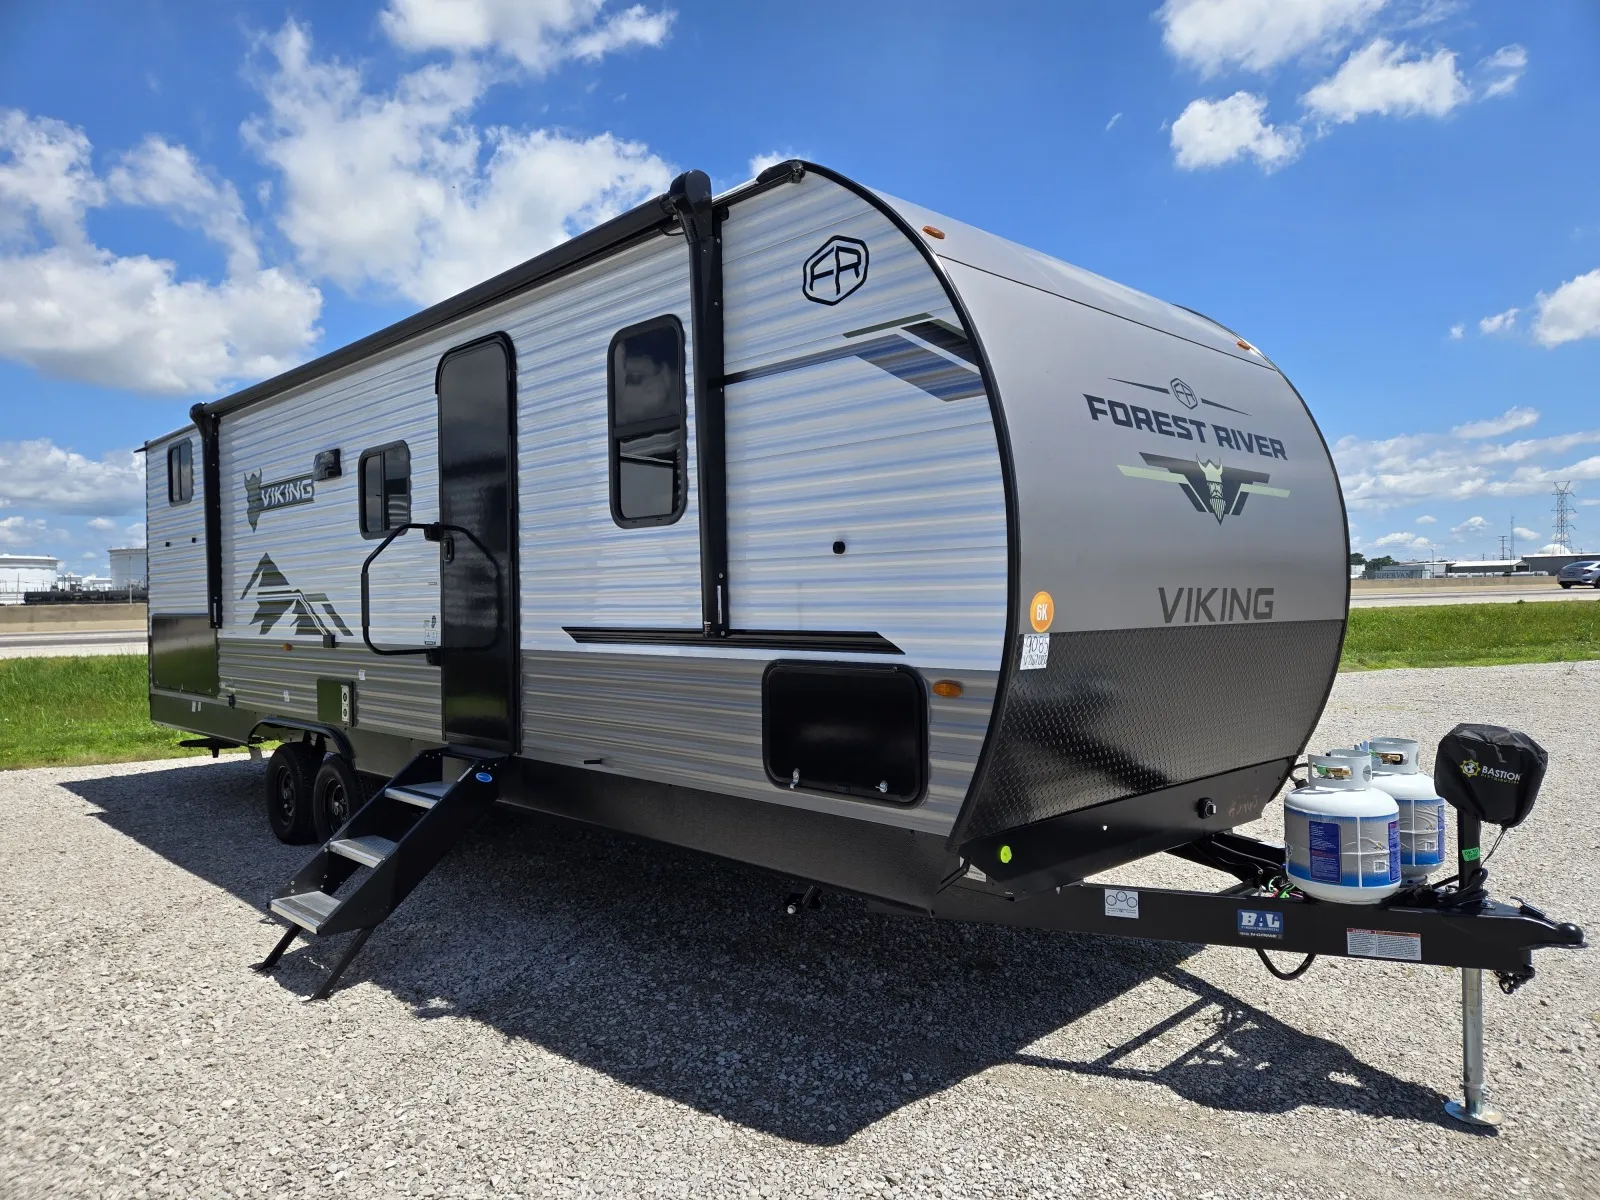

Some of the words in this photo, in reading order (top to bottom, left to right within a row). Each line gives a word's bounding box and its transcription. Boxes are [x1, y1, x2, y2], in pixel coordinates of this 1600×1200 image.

[1083, 393, 1207, 443] FOREST
[1210, 423, 1288, 461] RIVER
[261, 478, 314, 507] VIKING
[1036, 603, 1049, 621] 6K
[1158, 587, 1274, 624] VIKING
[1481, 765, 1521, 782] BASTION
[1241, 911, 1281, 929] BAL
